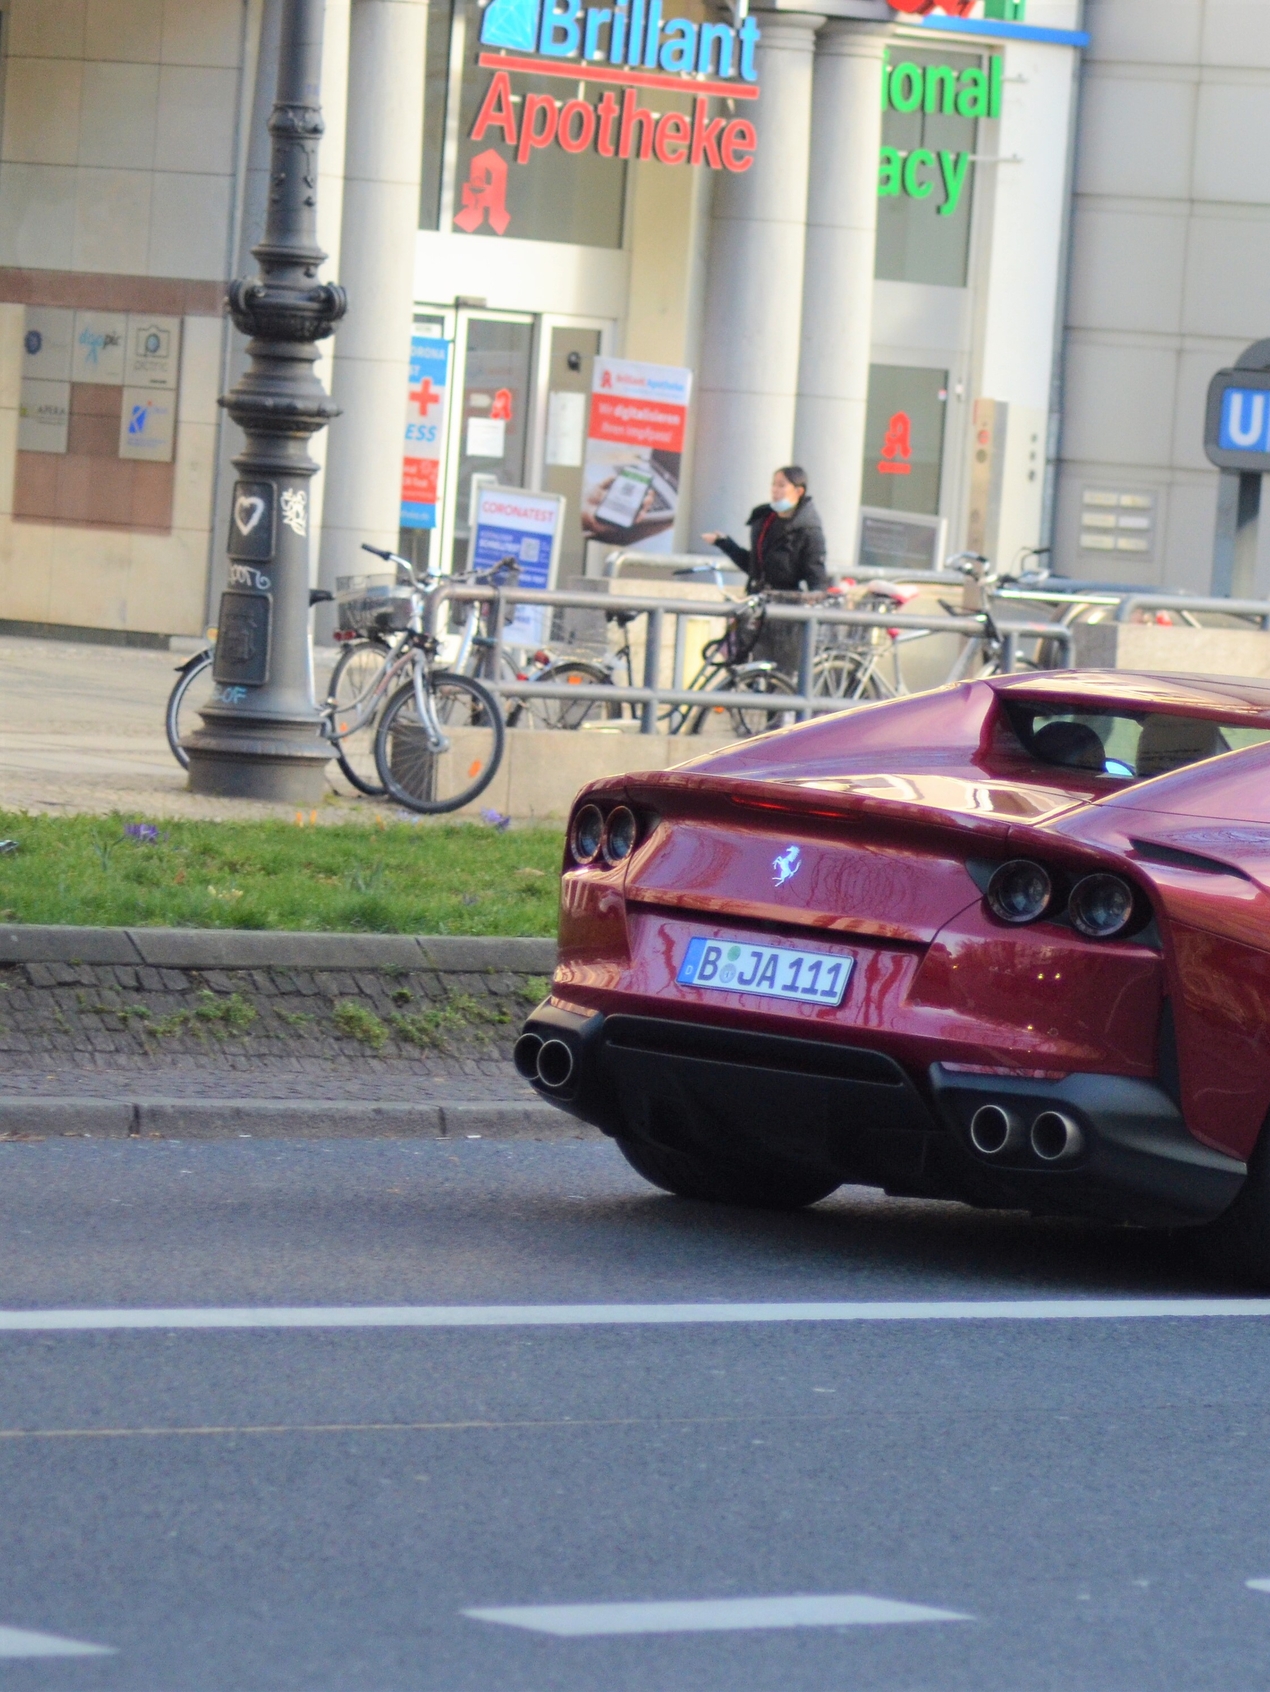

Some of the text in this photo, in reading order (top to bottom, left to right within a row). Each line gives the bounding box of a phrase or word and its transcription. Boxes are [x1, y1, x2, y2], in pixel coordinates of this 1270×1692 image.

[539, 0, 761, 82] Brillant
[471, 71, 758, 172] Apotheke
[877, 146, 970, 217] acy
[1228, 393, 1265, 447] U
[482, 501, 555, 522] CORONATEST
[685, 945, 843, 998] D B JA 111
